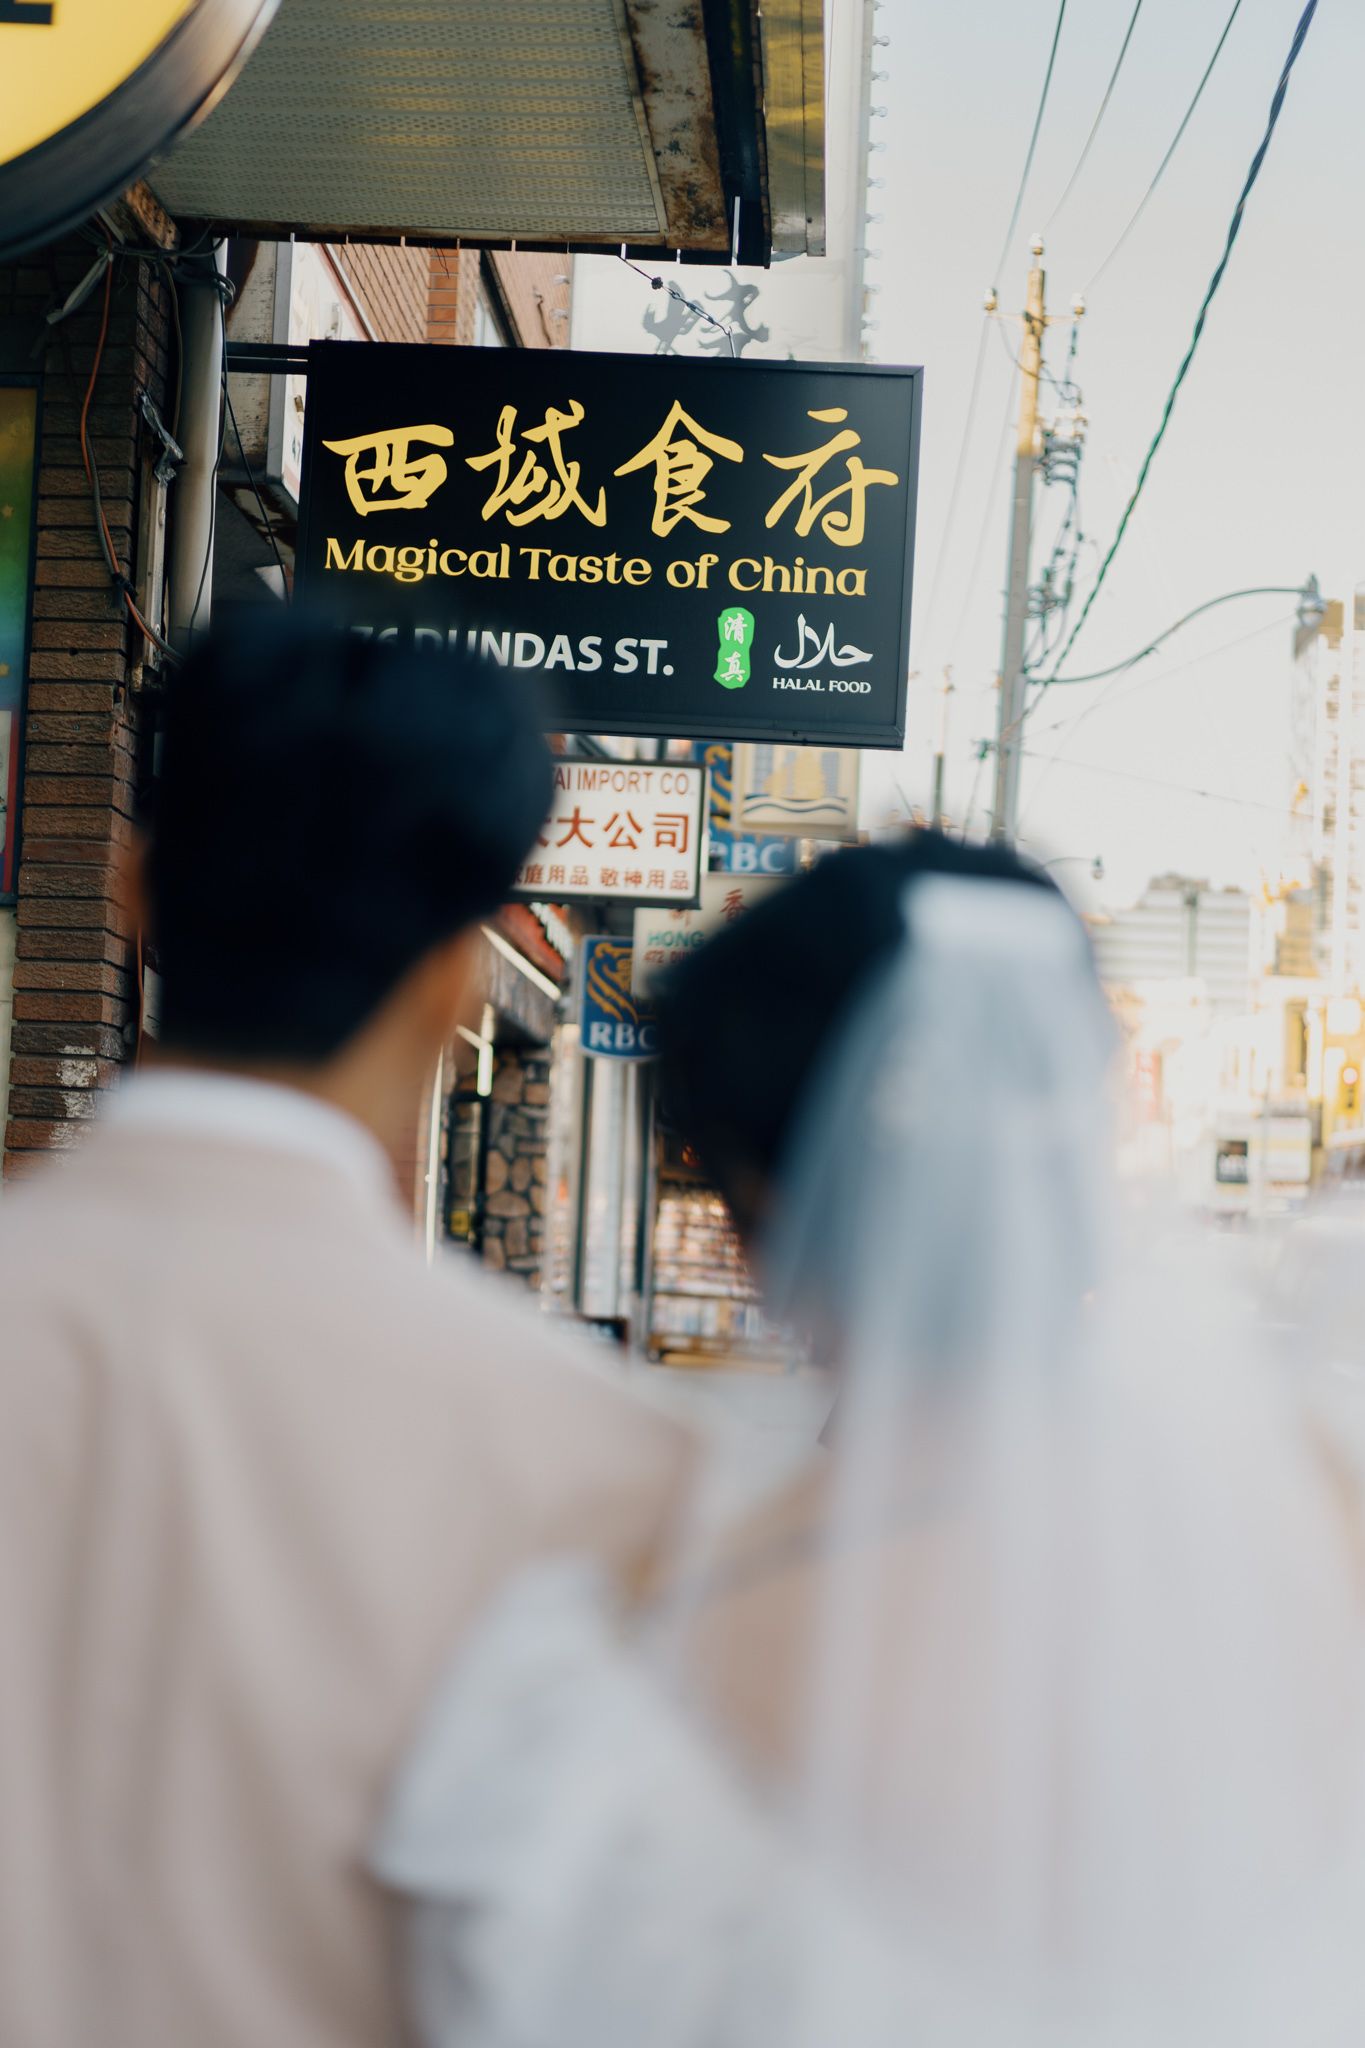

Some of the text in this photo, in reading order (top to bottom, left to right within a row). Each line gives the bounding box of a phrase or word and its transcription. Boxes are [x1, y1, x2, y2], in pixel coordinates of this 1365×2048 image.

[322, 400, 898, 546] 西域食府
[325, 538, 868, 596] Magical Taste of China
[613, 637, 674, 676] ST.
[720, 612, 748, 683] 清真
[773, 613, 873, 669] حلال
[772, 677, 872, 694] HALAL FOOD
[577, 768, 653, 793] IMPORT
[589, 1020, 657, 1050] RBC
